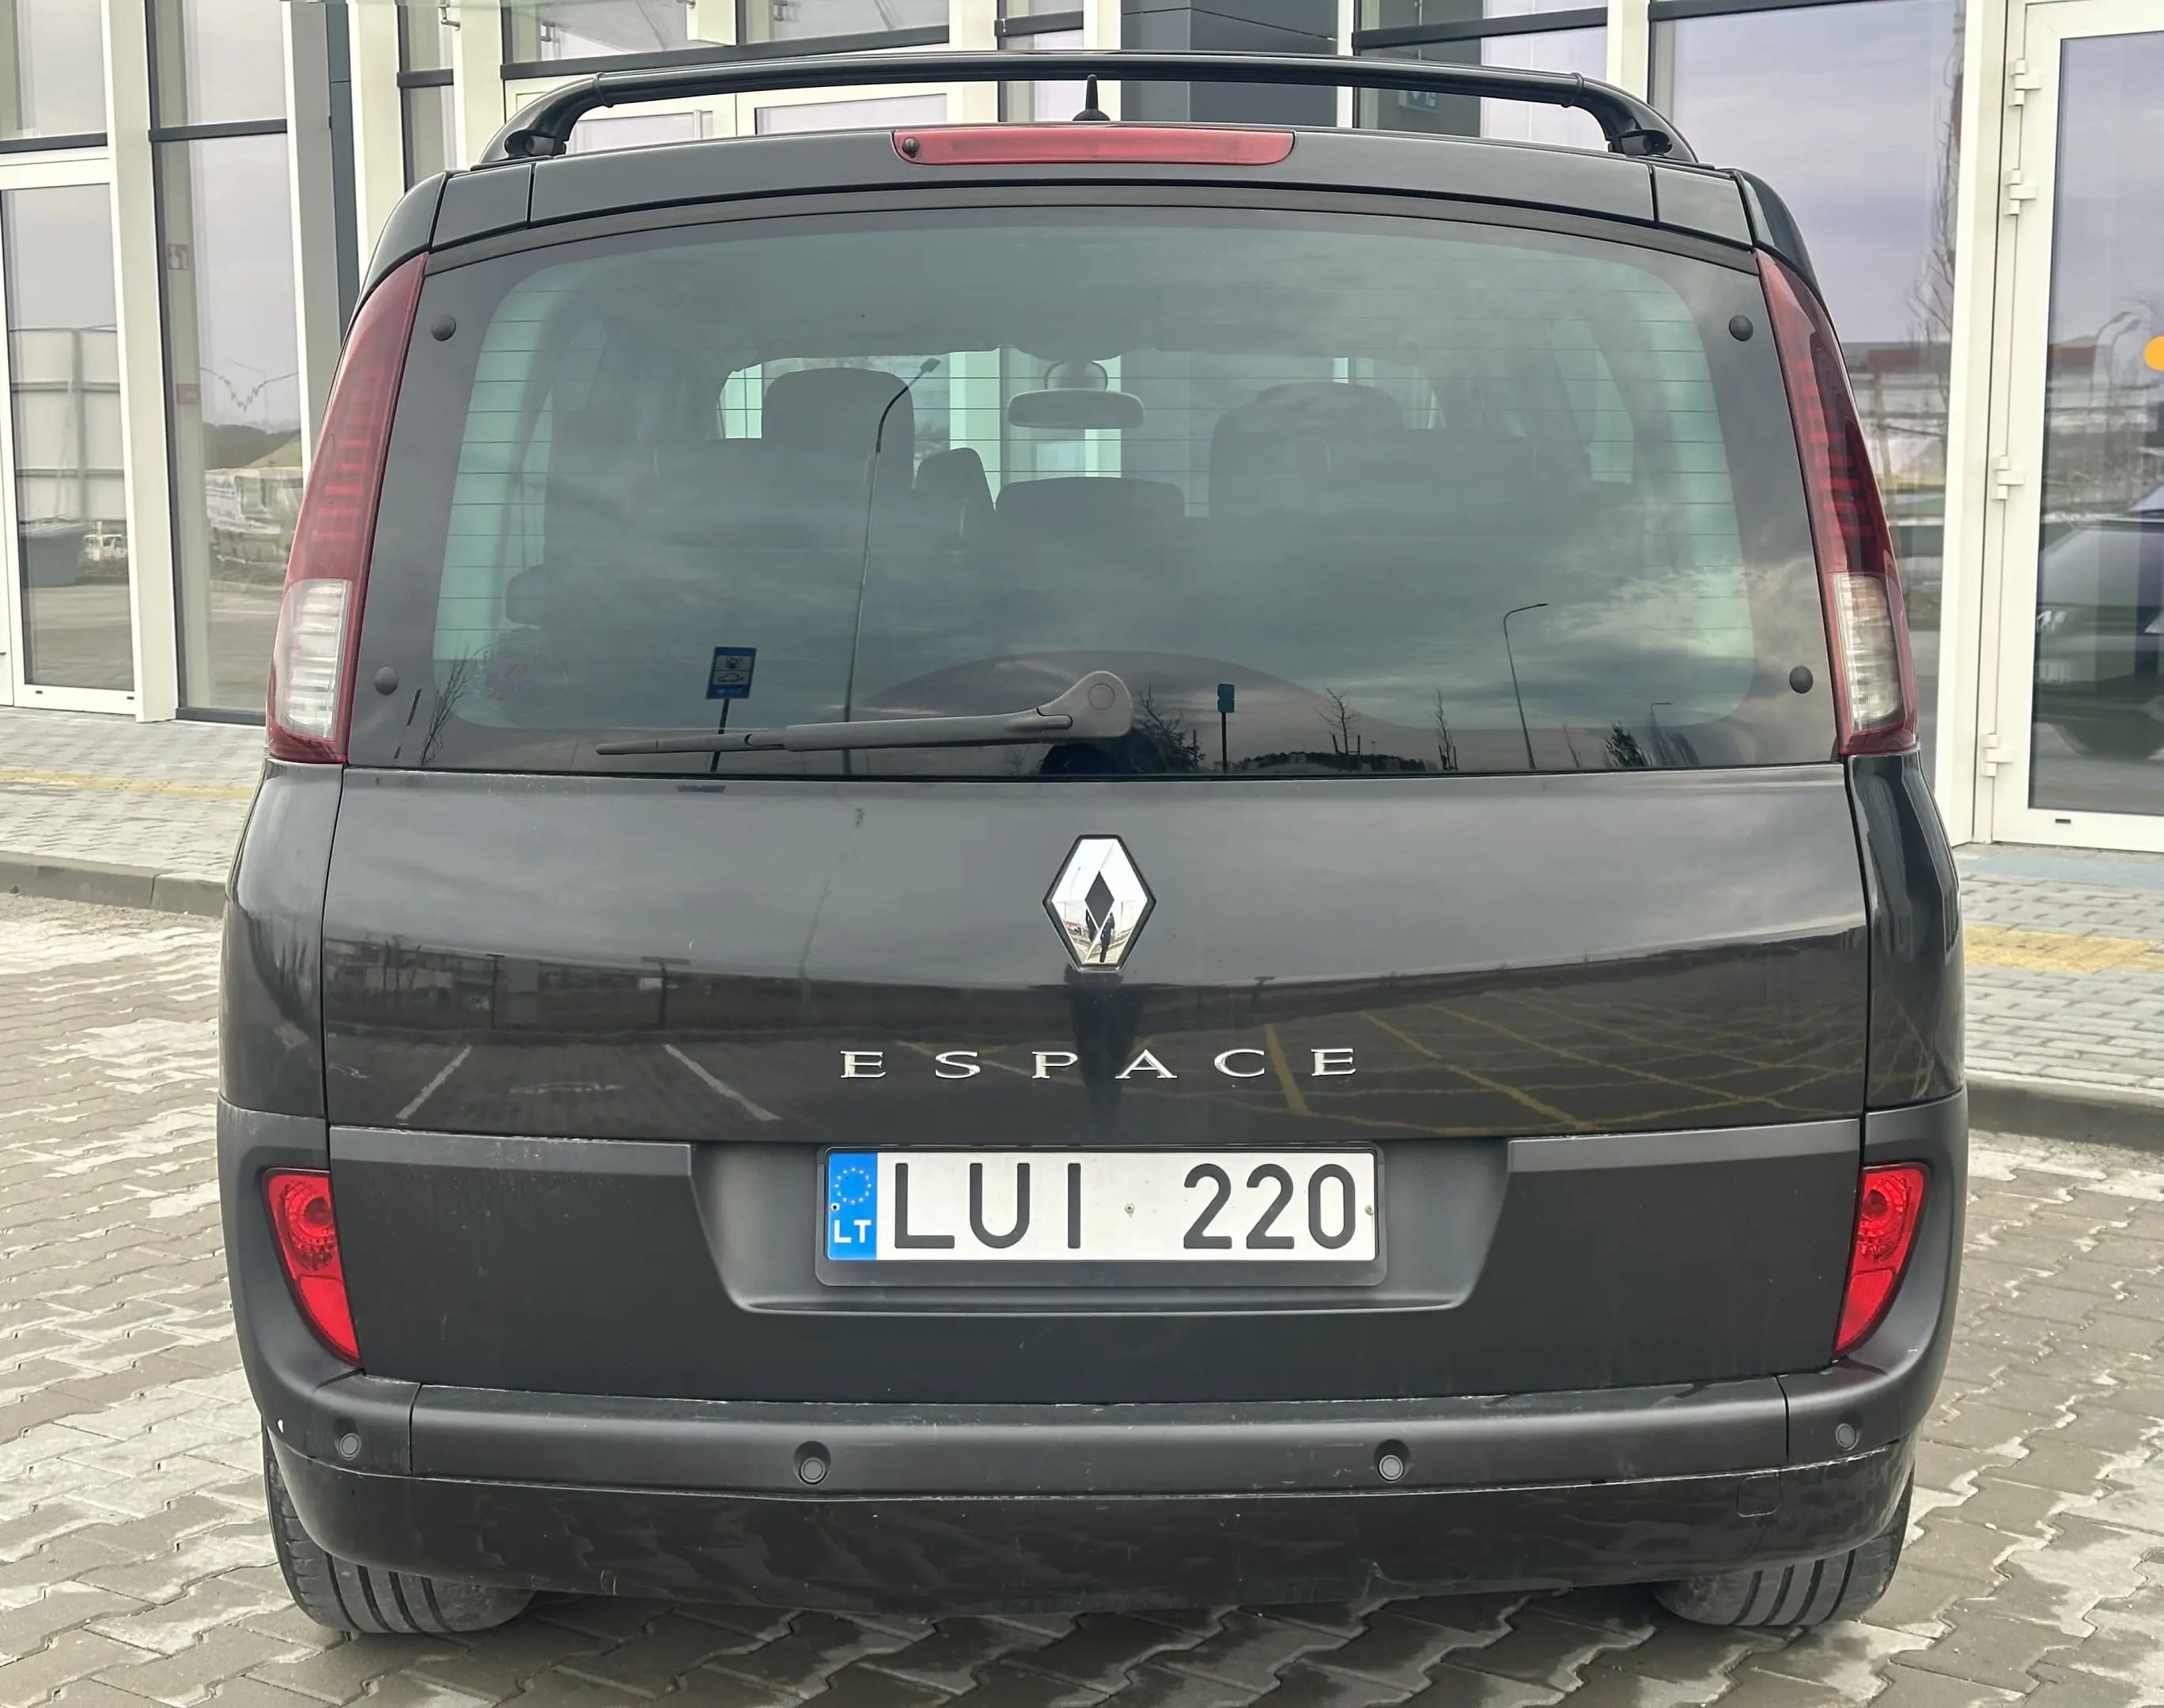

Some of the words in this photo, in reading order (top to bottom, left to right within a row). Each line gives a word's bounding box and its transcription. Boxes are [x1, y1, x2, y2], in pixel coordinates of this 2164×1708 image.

[840, 1048, 1356, 1079] ESPACE
[894, 1162, 1081, 1249] LUI
[1183, 1163, 1356, 1249] 220
[834, 1219, 872, 1244] LT
